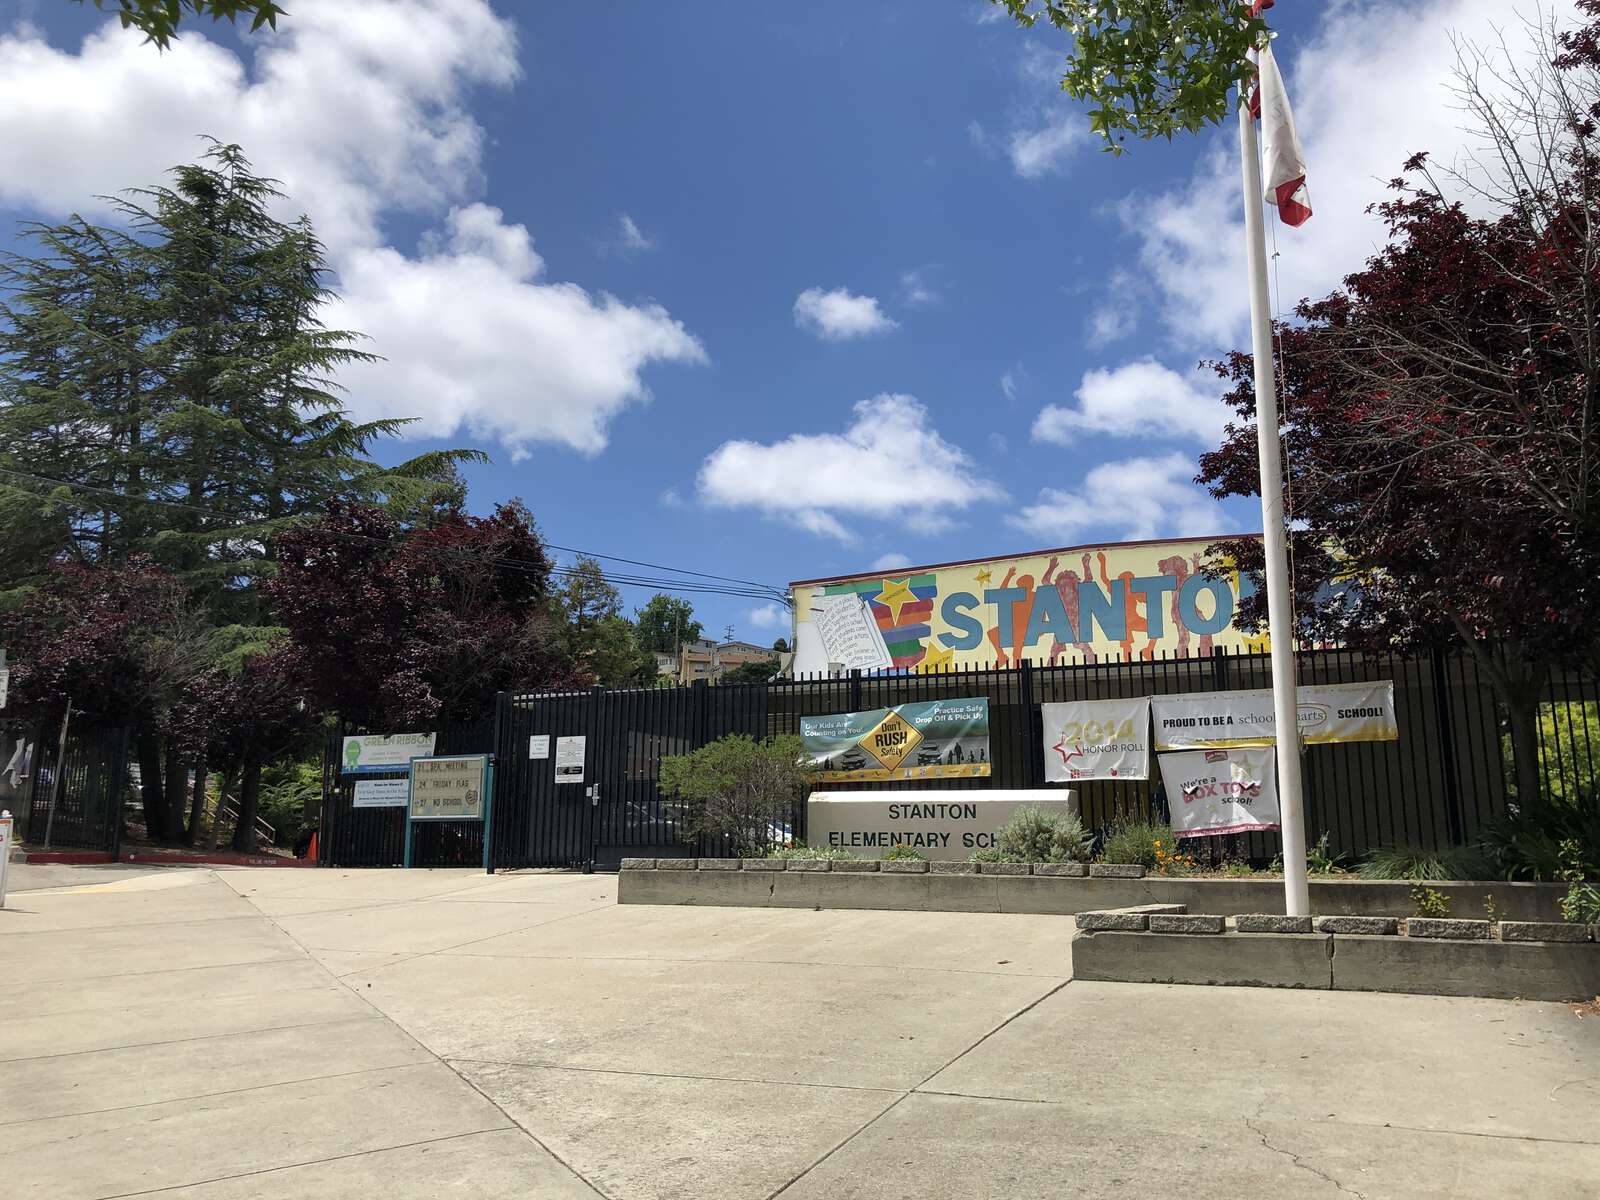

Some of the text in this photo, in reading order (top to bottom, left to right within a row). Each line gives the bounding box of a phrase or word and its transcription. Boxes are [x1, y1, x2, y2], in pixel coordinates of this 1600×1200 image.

[934, 706, 964, 714] Practice
[915, 716, 932, 724] Drop
[1163, 707, 1384, 728] PROUD TO BE A school arts SCHOOL!
[820, 721, 834, 729] Kids
[881, 721, 901, 732] Don't
[1065, 719, 1136, 746] 2014
[363, 735, 432, 747] GREEN RIBBON
[874, 731, 908, 747] RUSH
[880, 747, 902, 757] Safety
[1082, 743, 1145, 754] HONOR ROLL
[1180, 778, 1208, 789] We're
[1182, 781, 1261, 804] BOX TOPS
[888, 803, 977, 819] STANTON
[828, 831, 998, 848] ELEMENTARY SCH
